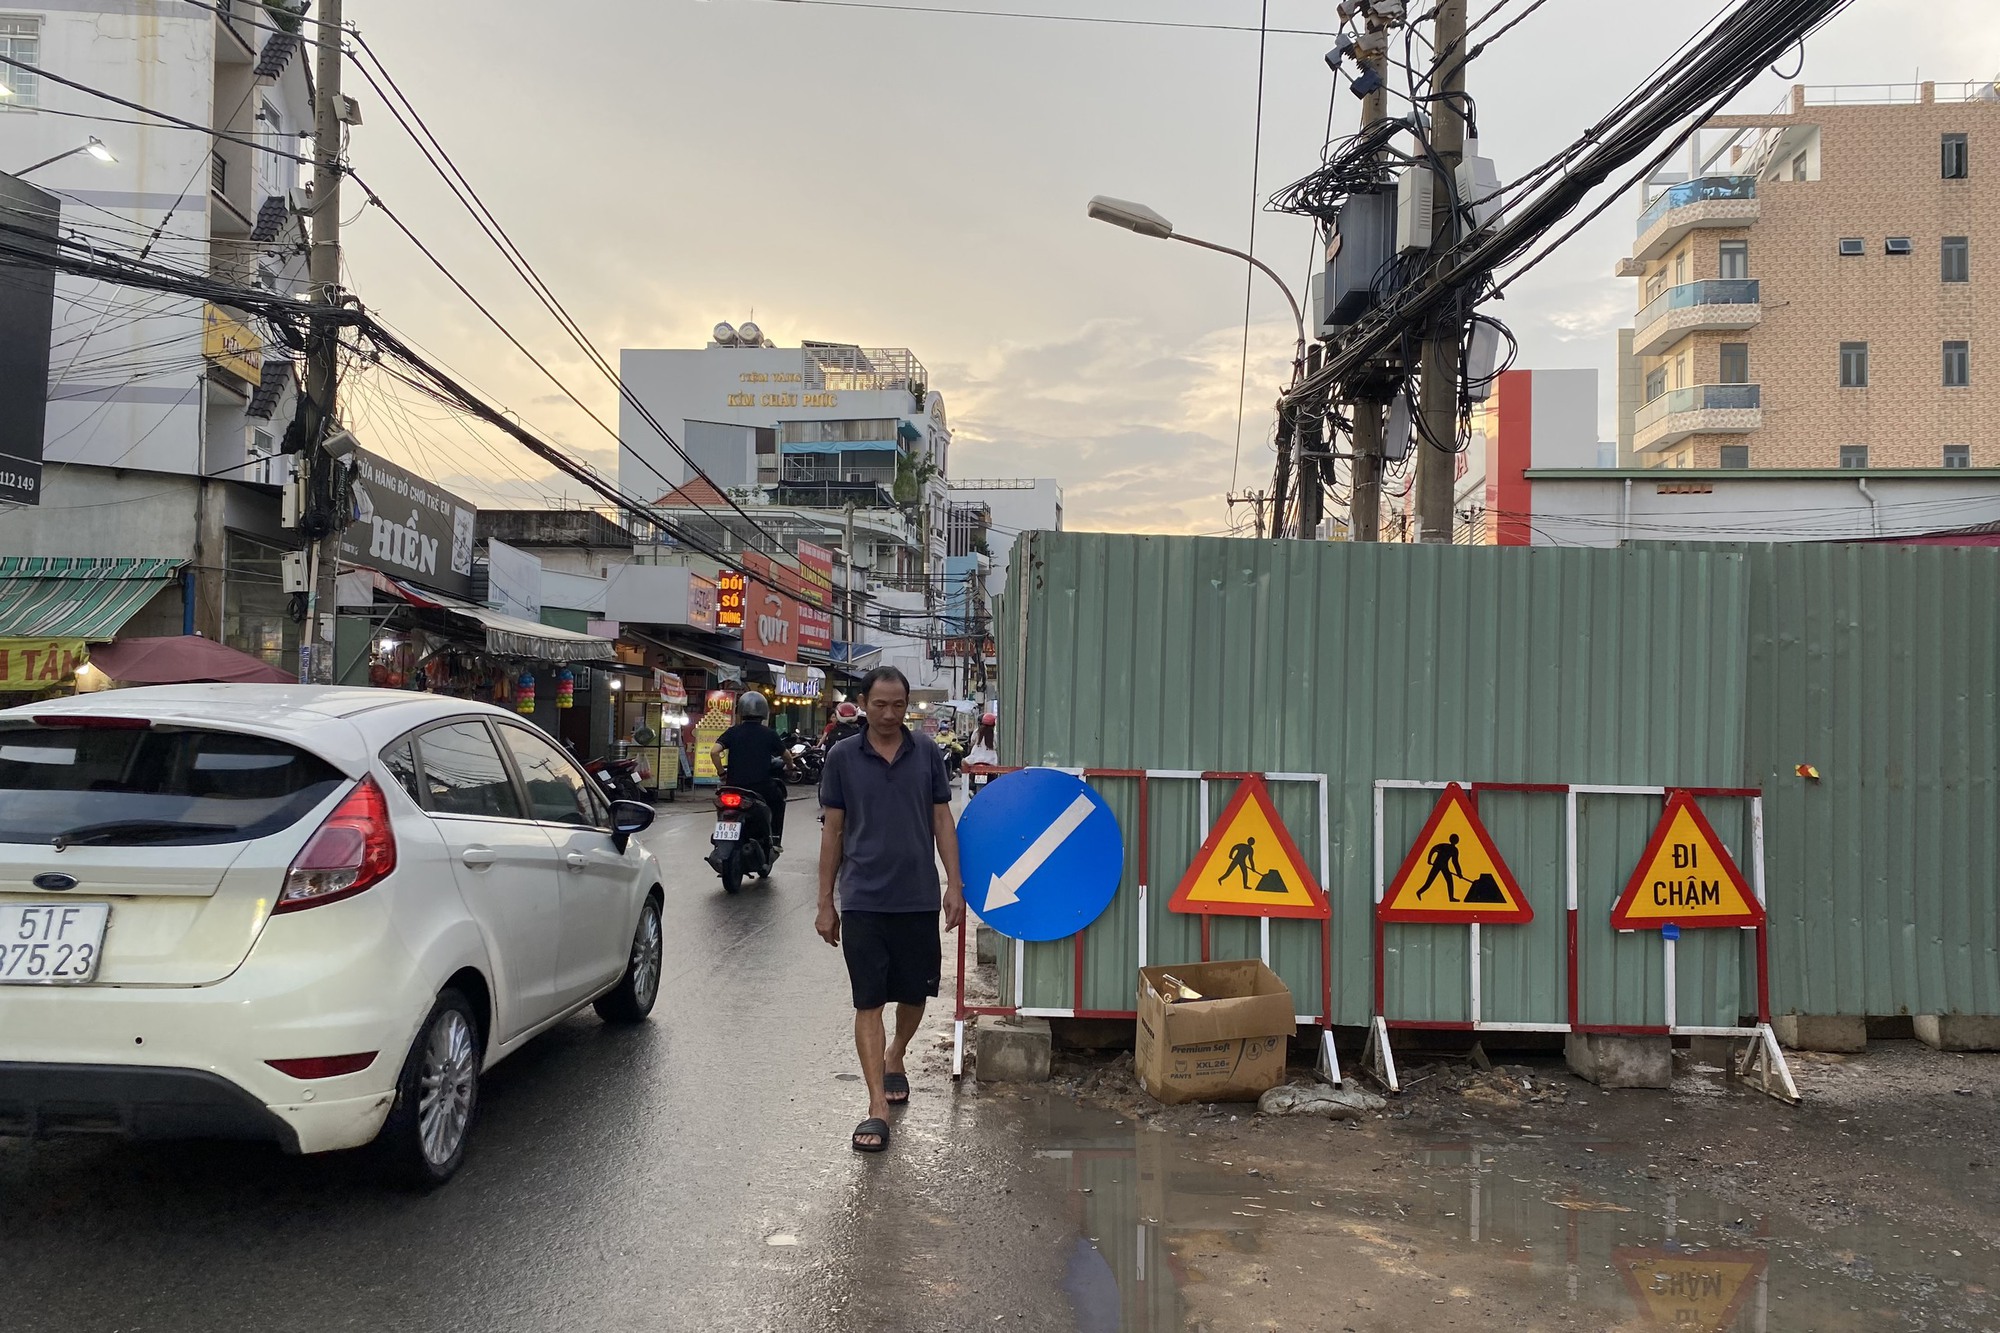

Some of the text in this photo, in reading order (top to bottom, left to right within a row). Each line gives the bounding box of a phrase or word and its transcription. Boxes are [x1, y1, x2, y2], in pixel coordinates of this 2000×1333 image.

[760, 392, 798, 407] CHÂU
[803, 392, 838, 407] PHÚC
[17, 475, 34, 490] 149
[375, 468, 396, 492] HÀNG
[440, 502, 450, 516] EM
[369, 509, 439, 576] HIỀN
[722, 592, 739, 607] SỐ
[719, 610, 741, 624] TRÚNG
[1672, 843, 1697, 869] ĐI
[1653, 875, 1720, 910] CHẬM
[18, 908, 80, 940] 51F
[1170, 1043, 1231, 1054] Premium Soft
